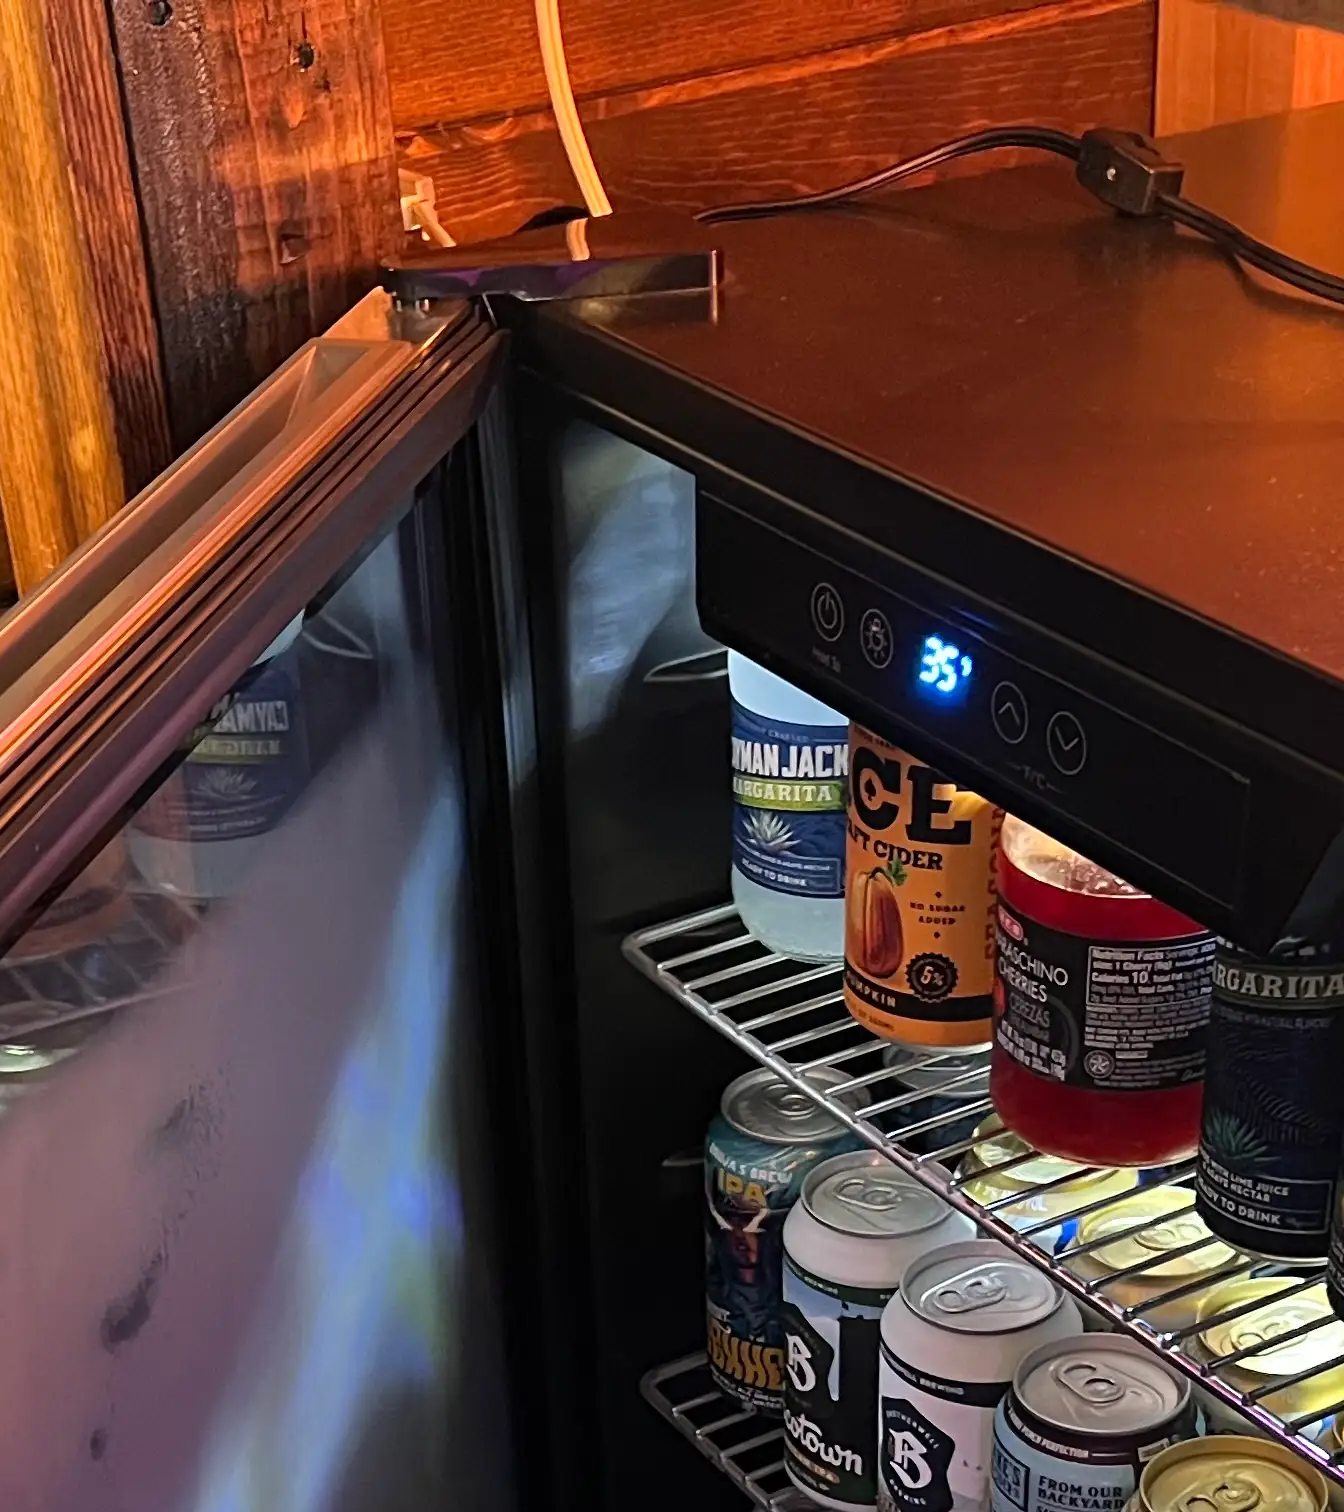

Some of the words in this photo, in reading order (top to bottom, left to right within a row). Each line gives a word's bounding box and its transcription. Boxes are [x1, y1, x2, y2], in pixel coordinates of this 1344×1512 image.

[732, 737, 779, 777] YMAN
[781, 744, 849, 778] JACK
[852, 747, 972, 845] CE
[873, 839, 944, 871] CIDER
[718, 1167, 766, 1207] IPA
[1229, 1182, 1272, 1203] NECTAR
[1255, 1181, 1291, 1197] JUICE
[1219, 1196, 1237, 1212] TO
[1237, 1204, 1282, 1226] DRINK
[1037, 1487, 1127, 1511] BACKYARD
[1038, 1474, 1083, 1497] FROM
[1087, 1485, 1124, 1499] OUR
